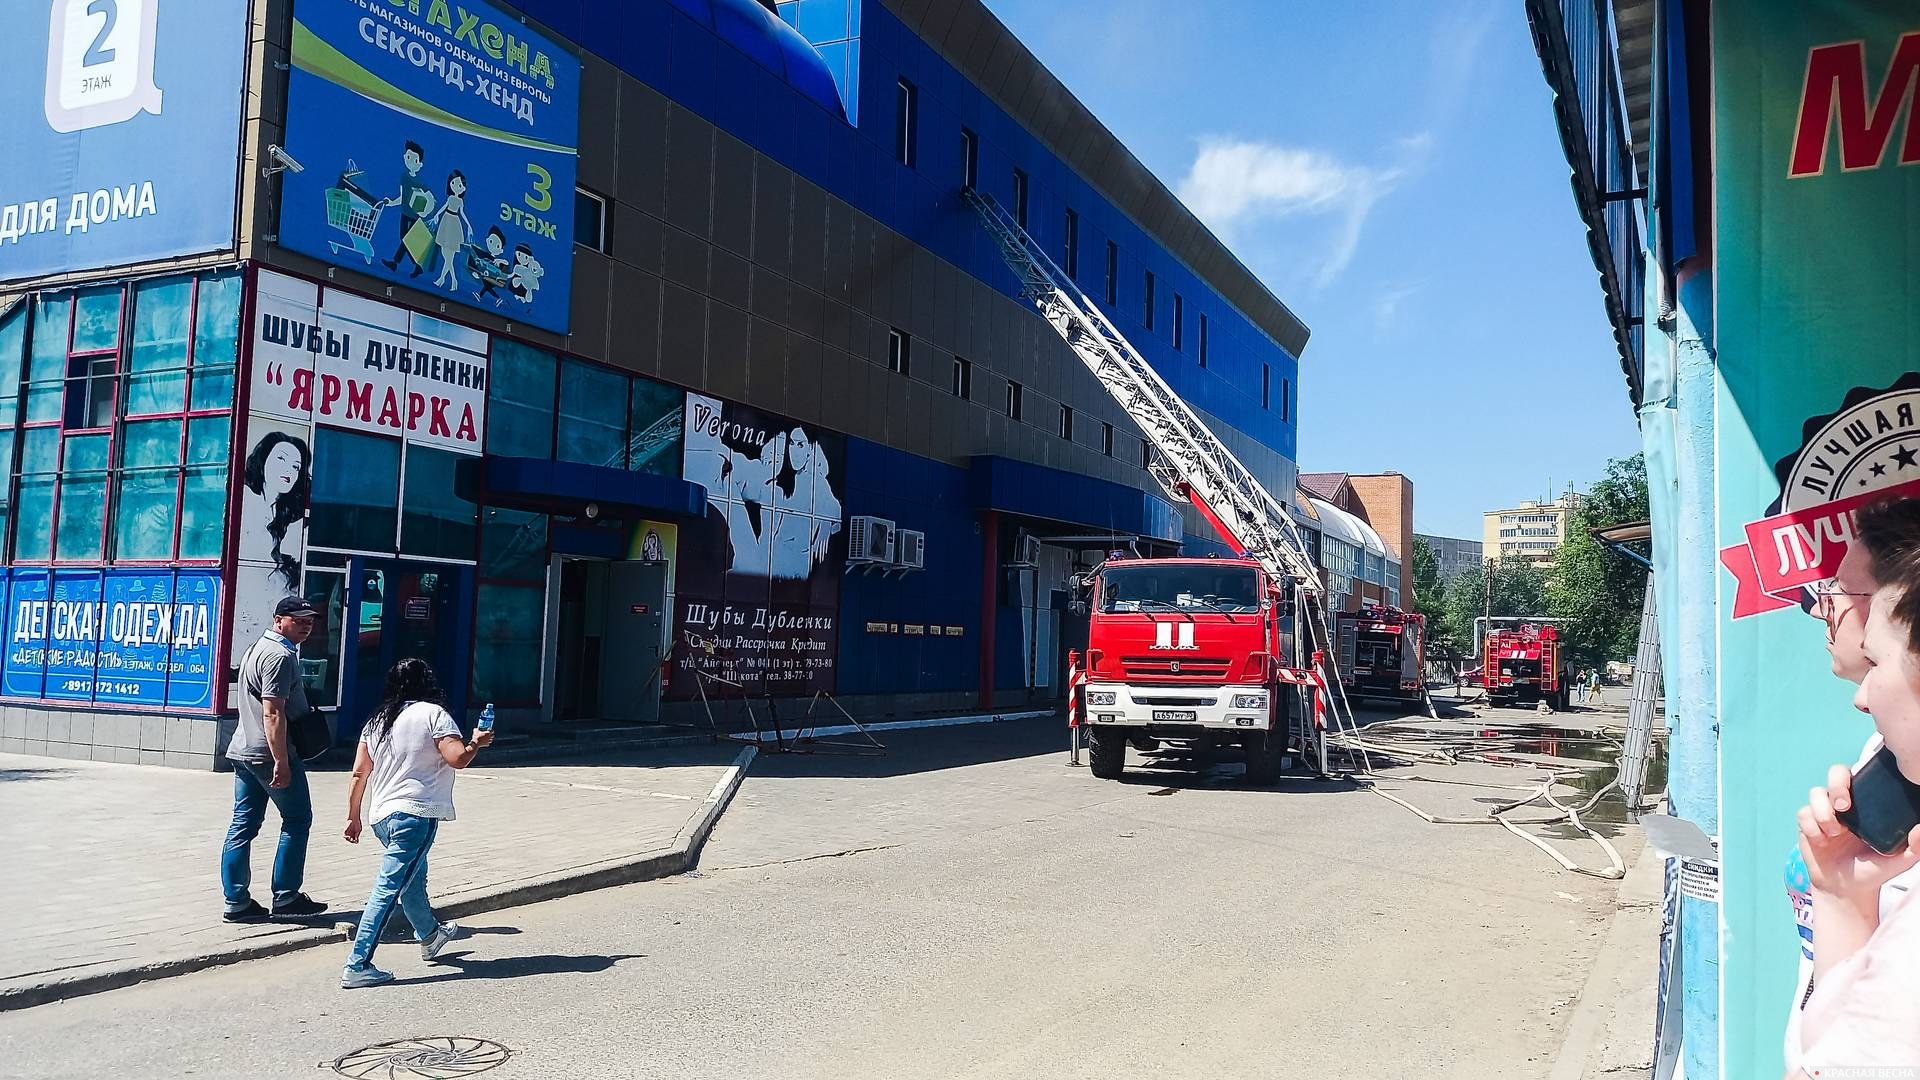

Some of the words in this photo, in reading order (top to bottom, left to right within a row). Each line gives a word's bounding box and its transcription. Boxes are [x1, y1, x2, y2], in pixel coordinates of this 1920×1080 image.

[82, 0, 118, 68] 2
[369, 2, 442, 47] МАГАЗИНОВ
[444, 39, 494, 75] ОДЕЖДЫ
[495, 66, 510, 83] ИЗ
[510, 75, 551, 105] ЕВРОПЫ
[81, 74, 112, 94] ЭТАЖ
[358, 17, 535, 127] СЕКОНД-ХЕНД
[0, 197, 58, 246] ДЛЯ
[65, 180, 157, 236] ДОМА
[524, 163, 552, 212] 3
[499, 202, 557, 241] этаж
[262, 313, 350, 361] ШУБЫ
[363, 339, 486, 391] ДУБЛЕНКИ
[693, 404, 766, 447] Verona
[1801, 402, 1914, 496] ЛУЧШАЯ
[1771, 508, 1860, 577] ЛУЧ
[14, 600, 108, 643] ДЕТСКАЯ
[111, 602, 209, 649] ОДЕЖДА
[685, 604, 745, 630] Шубы
[752, 608, 832, 633] Дубленки
[115, 684, 140, 695] 1412
